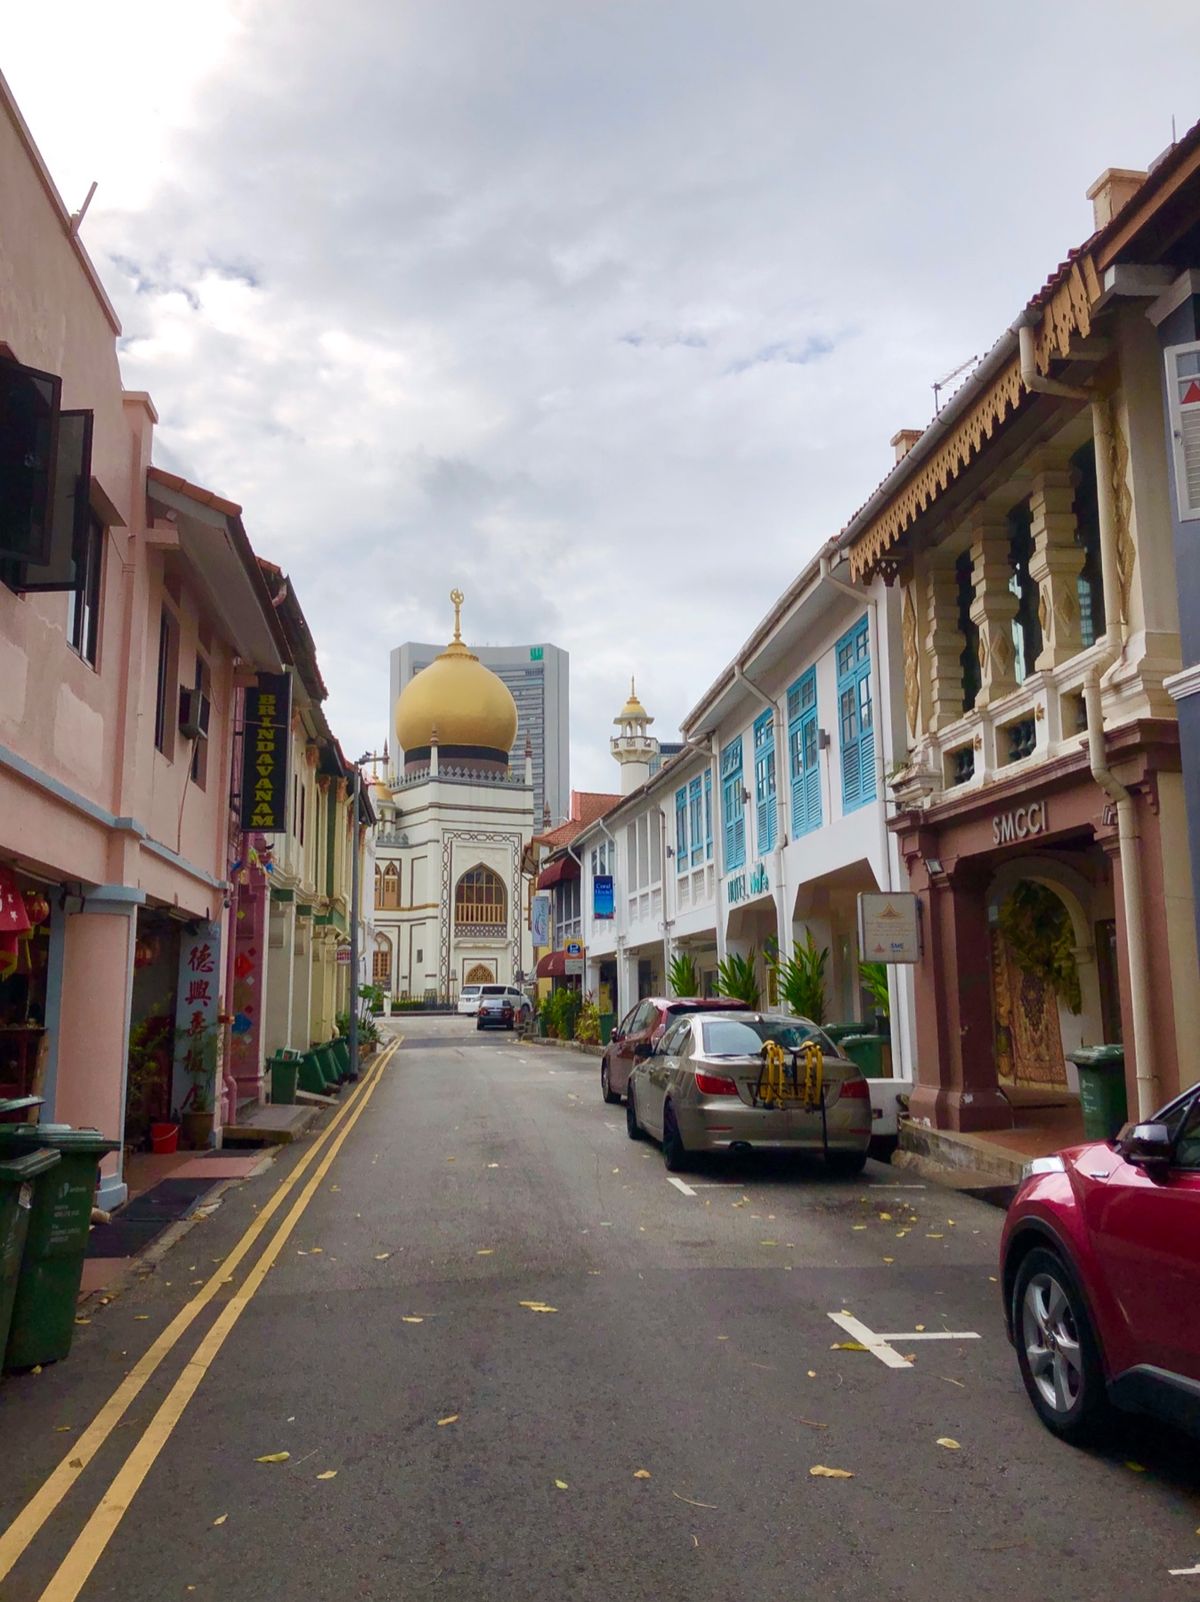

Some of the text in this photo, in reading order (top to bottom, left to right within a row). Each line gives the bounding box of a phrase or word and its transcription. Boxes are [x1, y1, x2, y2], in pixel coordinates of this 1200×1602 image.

[251, 694, 276, 827] BRINDAVANAM
[992, 800, 1046, 845] SMCCI
[728, 874, 750, 904] HOTEL
